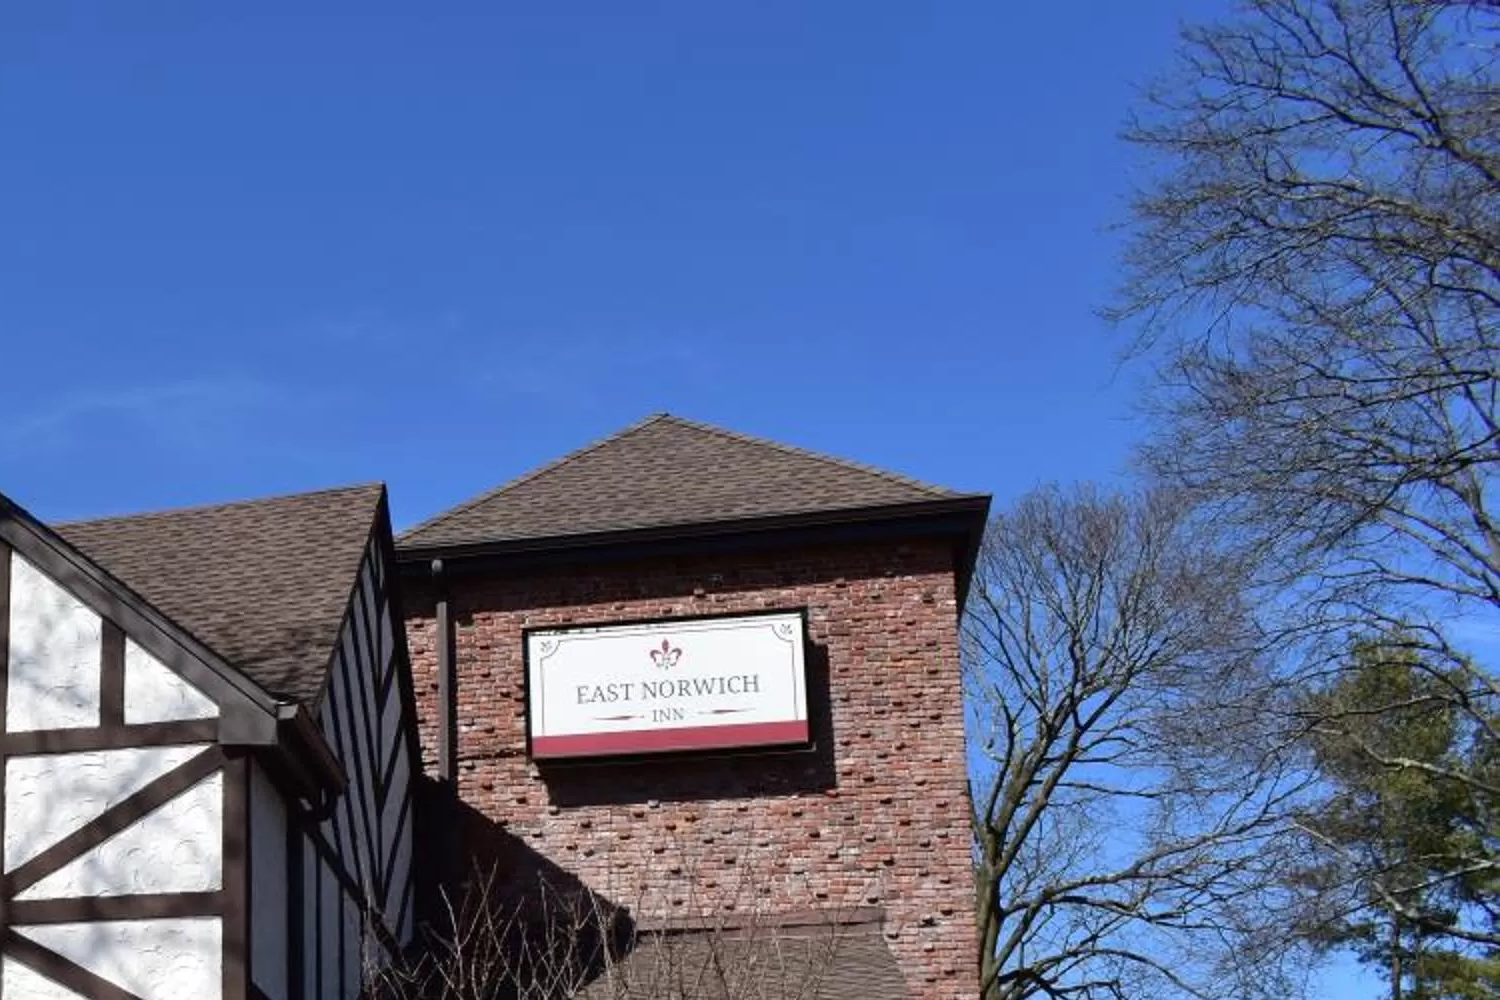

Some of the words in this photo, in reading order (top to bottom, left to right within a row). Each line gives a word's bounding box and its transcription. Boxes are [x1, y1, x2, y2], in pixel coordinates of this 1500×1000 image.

[576, 682, 634, 705] EAST
[642, 675, 760, 700] NORWICH
[652, 707, 685, 723] INN
